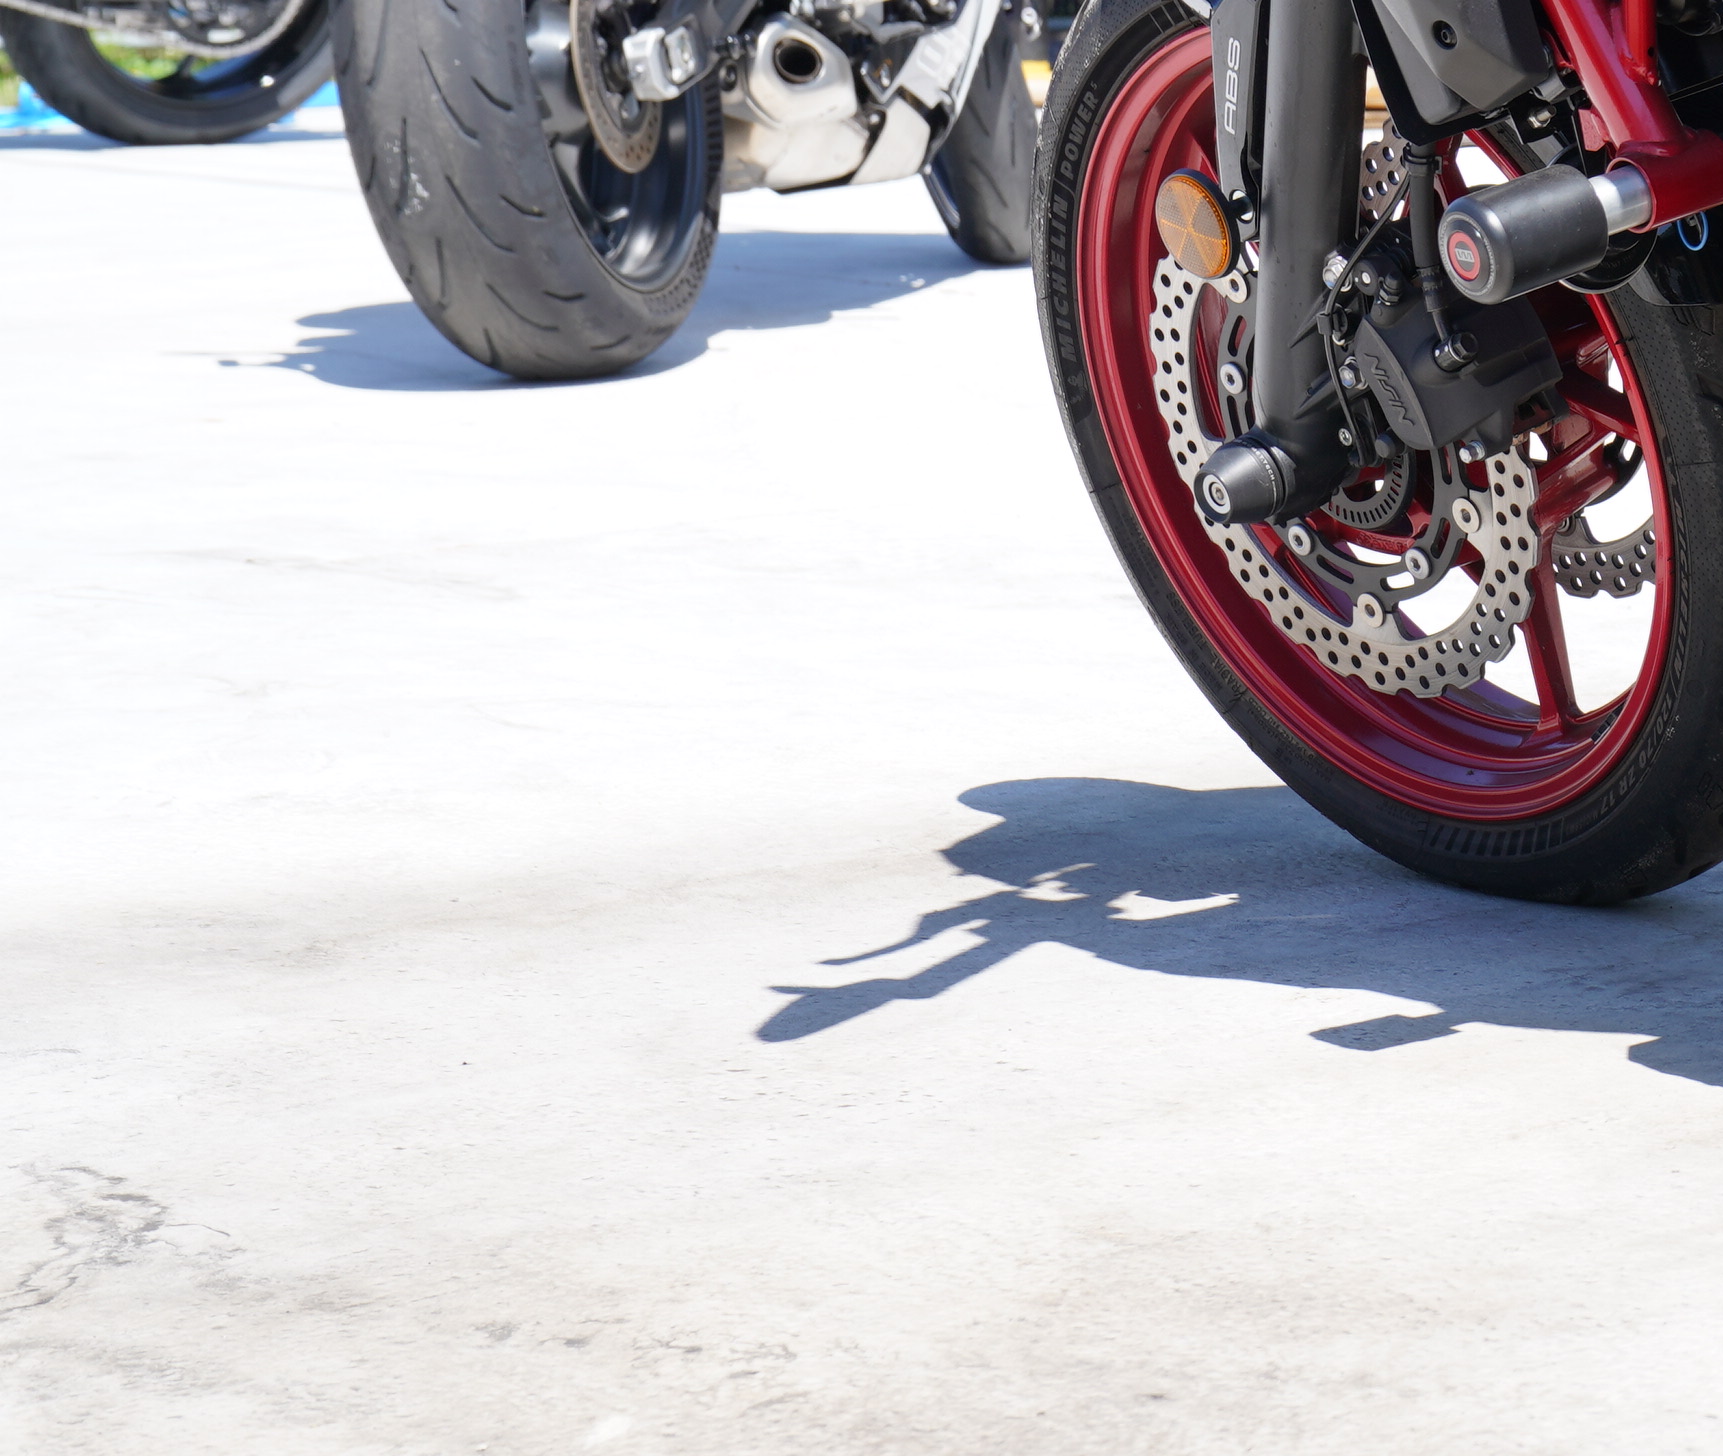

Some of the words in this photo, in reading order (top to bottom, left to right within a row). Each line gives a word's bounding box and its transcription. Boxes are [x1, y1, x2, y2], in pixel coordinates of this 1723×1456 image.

[1224, 36, 1241, 135] ABS
[1060, 91, 1099, 182] POWER
[1050, 195, 1077, 363] MICHELIN
[1673, 498, 1689, 680] MICHELIN
[1638, 692, 1673, 769] 120/70
